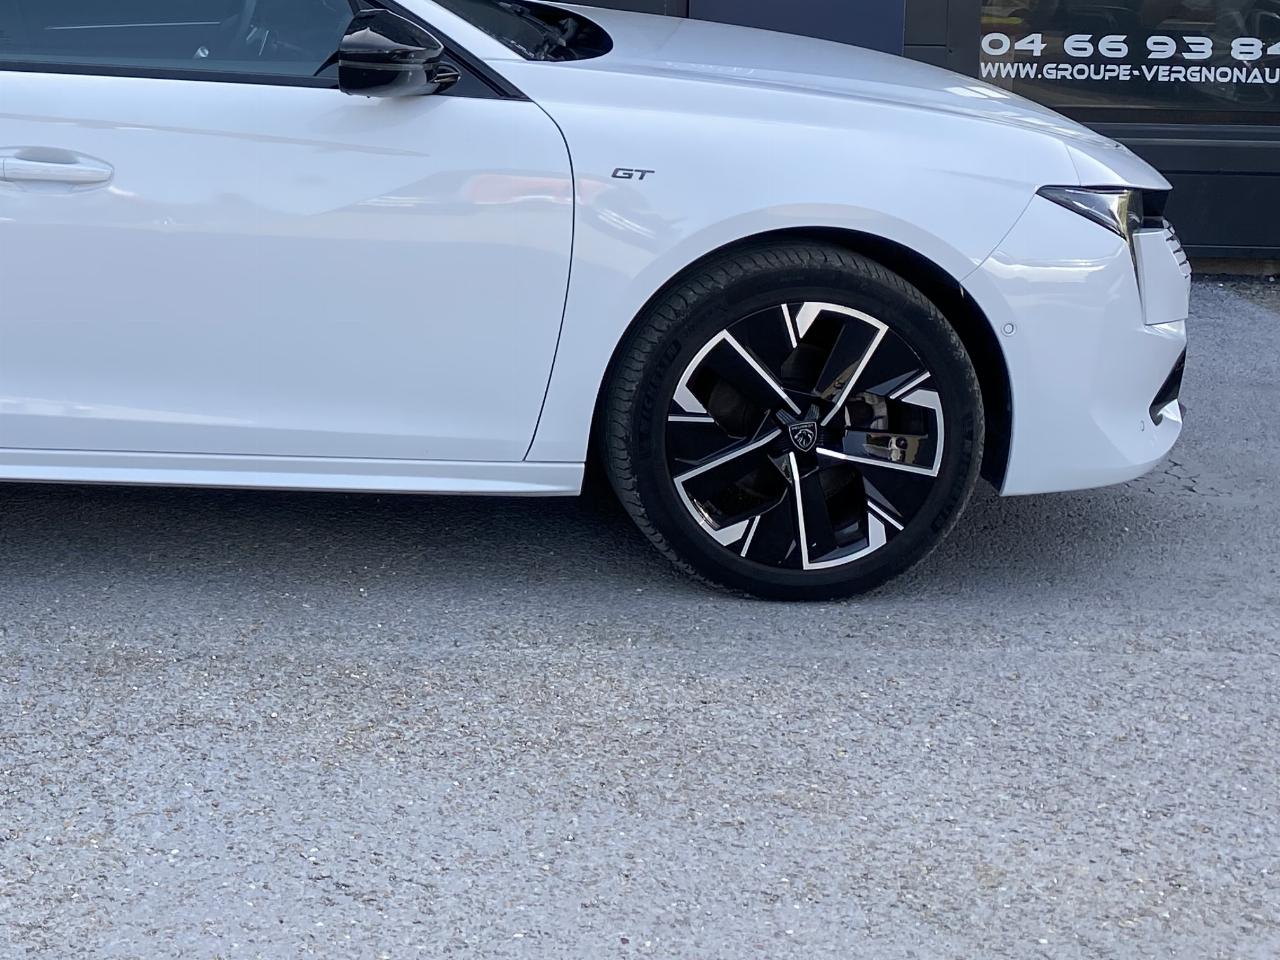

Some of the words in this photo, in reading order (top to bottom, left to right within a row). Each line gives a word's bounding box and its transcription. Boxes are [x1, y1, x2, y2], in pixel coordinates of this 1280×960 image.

[981, 32, 1047, 56] 04
[1063, 34, 1129, 58] 66
[1146, 35, 1213, 59] 93
[611, 167, 655, 180] GT
